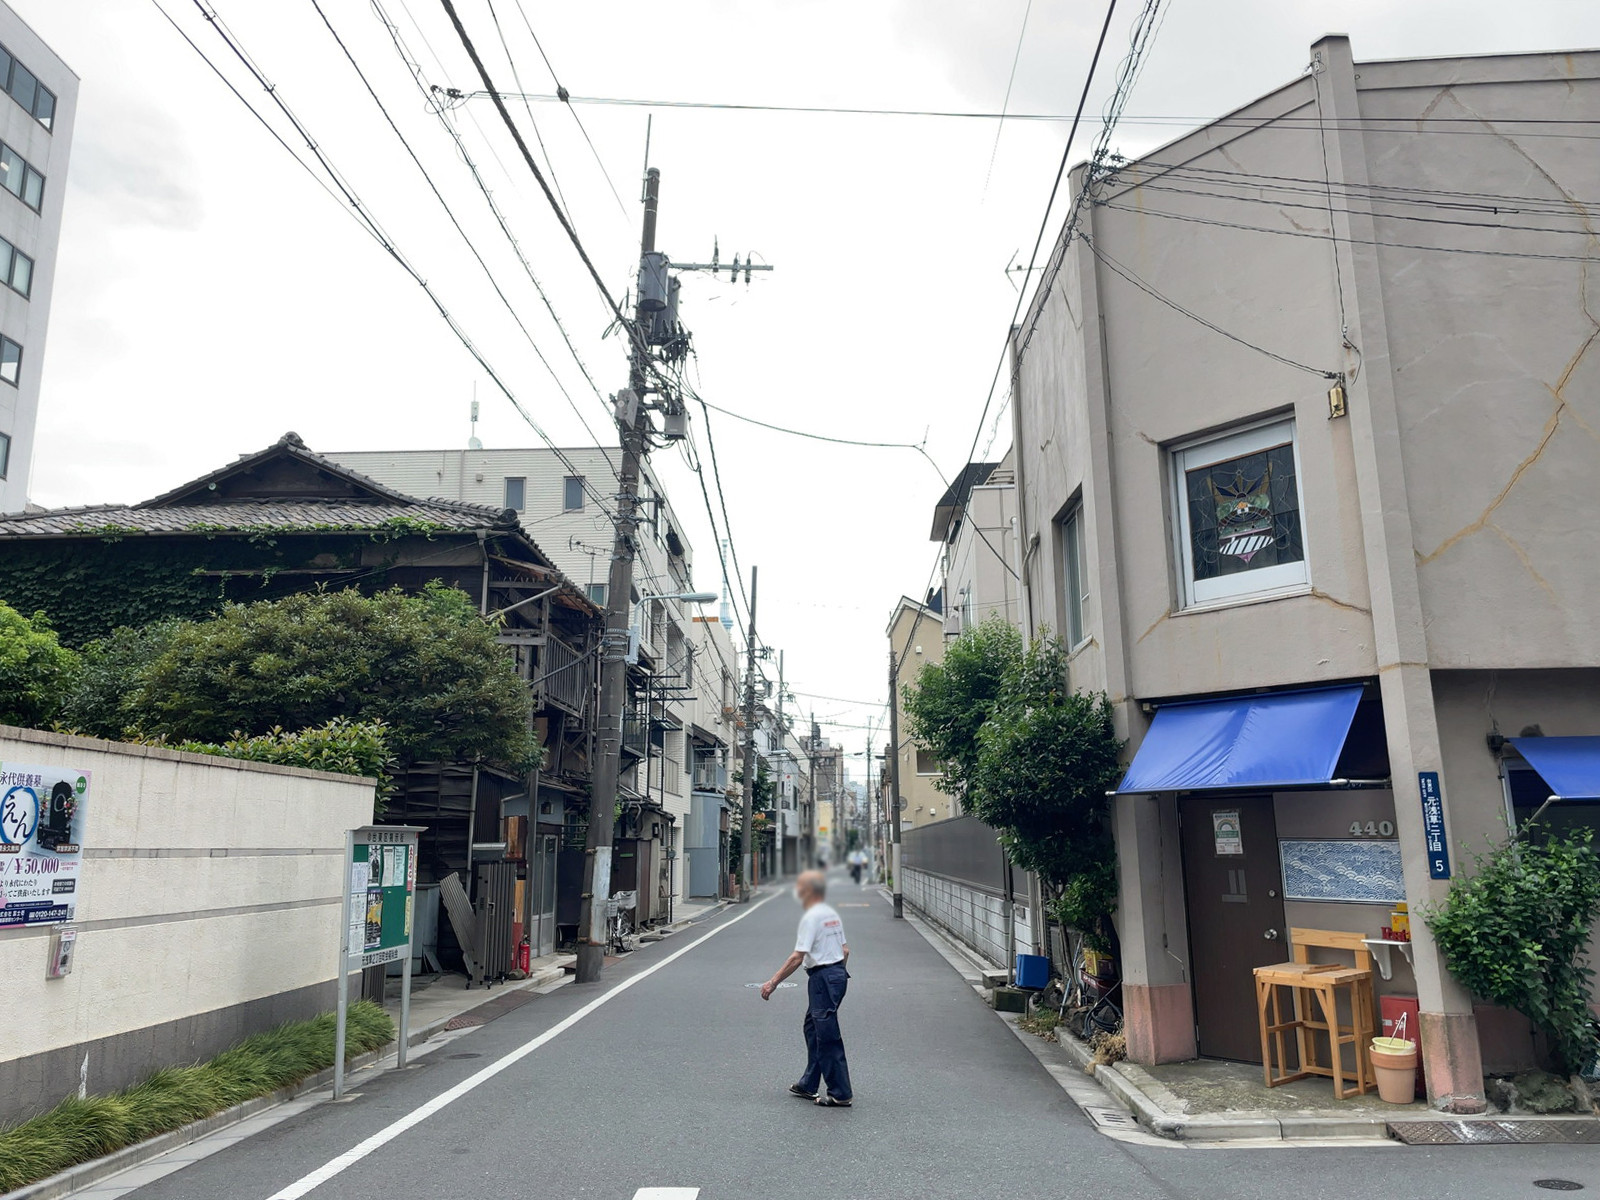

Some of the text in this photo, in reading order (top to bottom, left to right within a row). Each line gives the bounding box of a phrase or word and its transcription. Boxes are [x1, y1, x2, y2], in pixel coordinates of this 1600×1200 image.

[0, 771, 42, 788] 永代供養墓
[3, 795, 31, 839] えん
[1427, 796, 1442, 852] 元浅草二丁目
[1349, 821, 1394, 836] 440
[1435, 859, 1444, 872] 5
